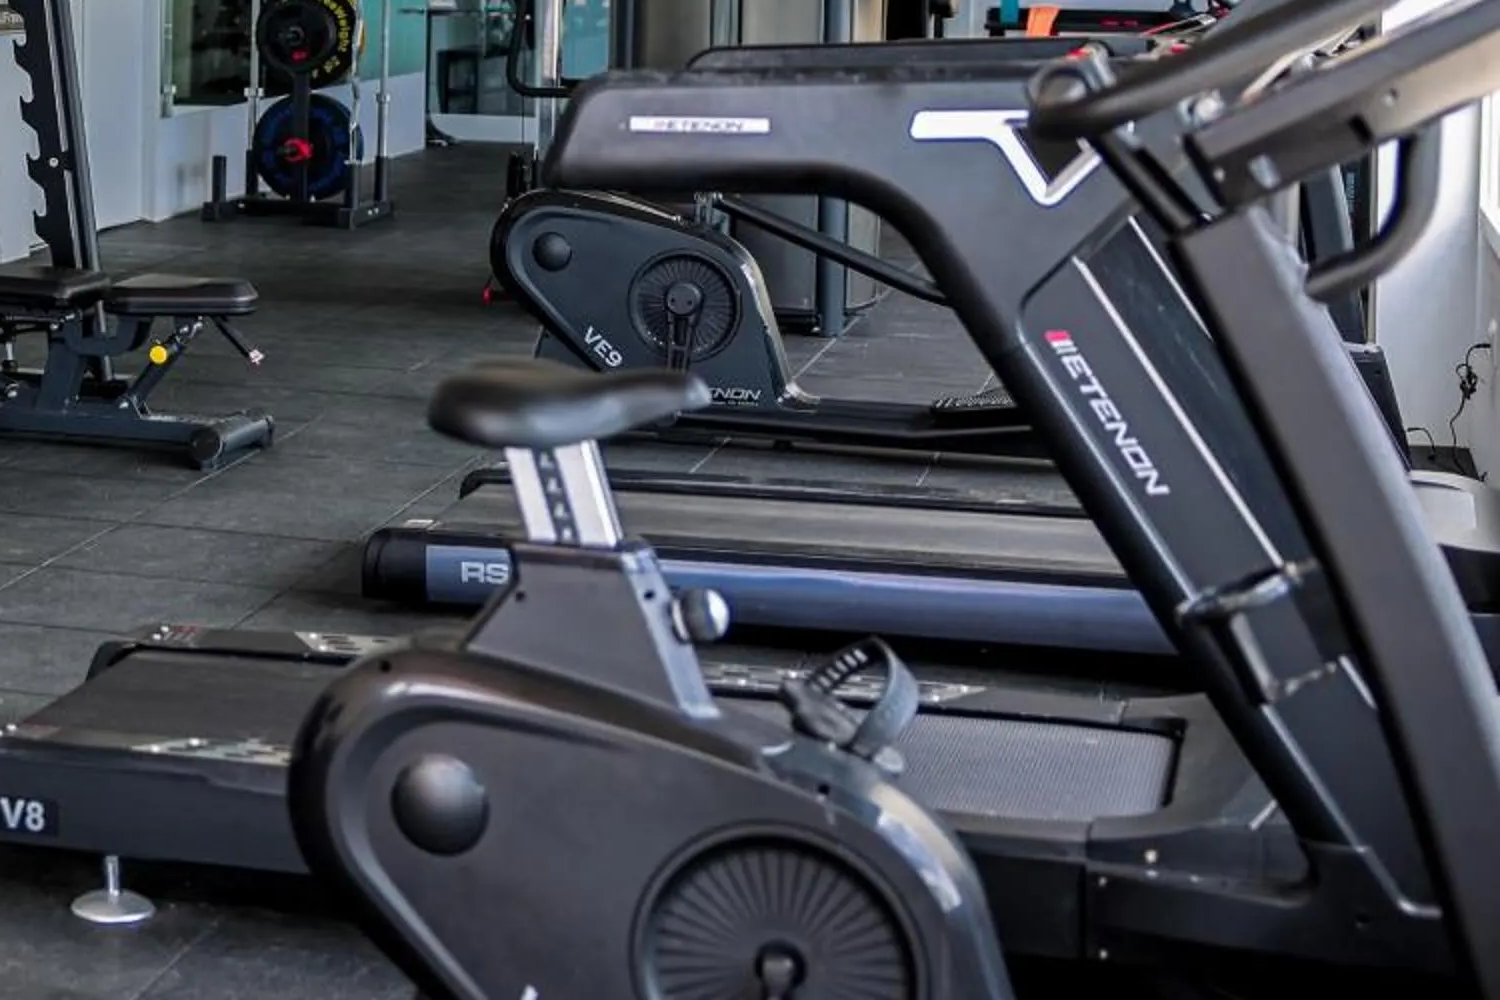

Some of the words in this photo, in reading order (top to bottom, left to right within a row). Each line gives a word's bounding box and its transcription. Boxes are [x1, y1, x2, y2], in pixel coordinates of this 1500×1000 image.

[583, 325, 624, 368] VE9
[1061, 354, 1171, 496] ETENON
[0, 796, 45, 832] V8
